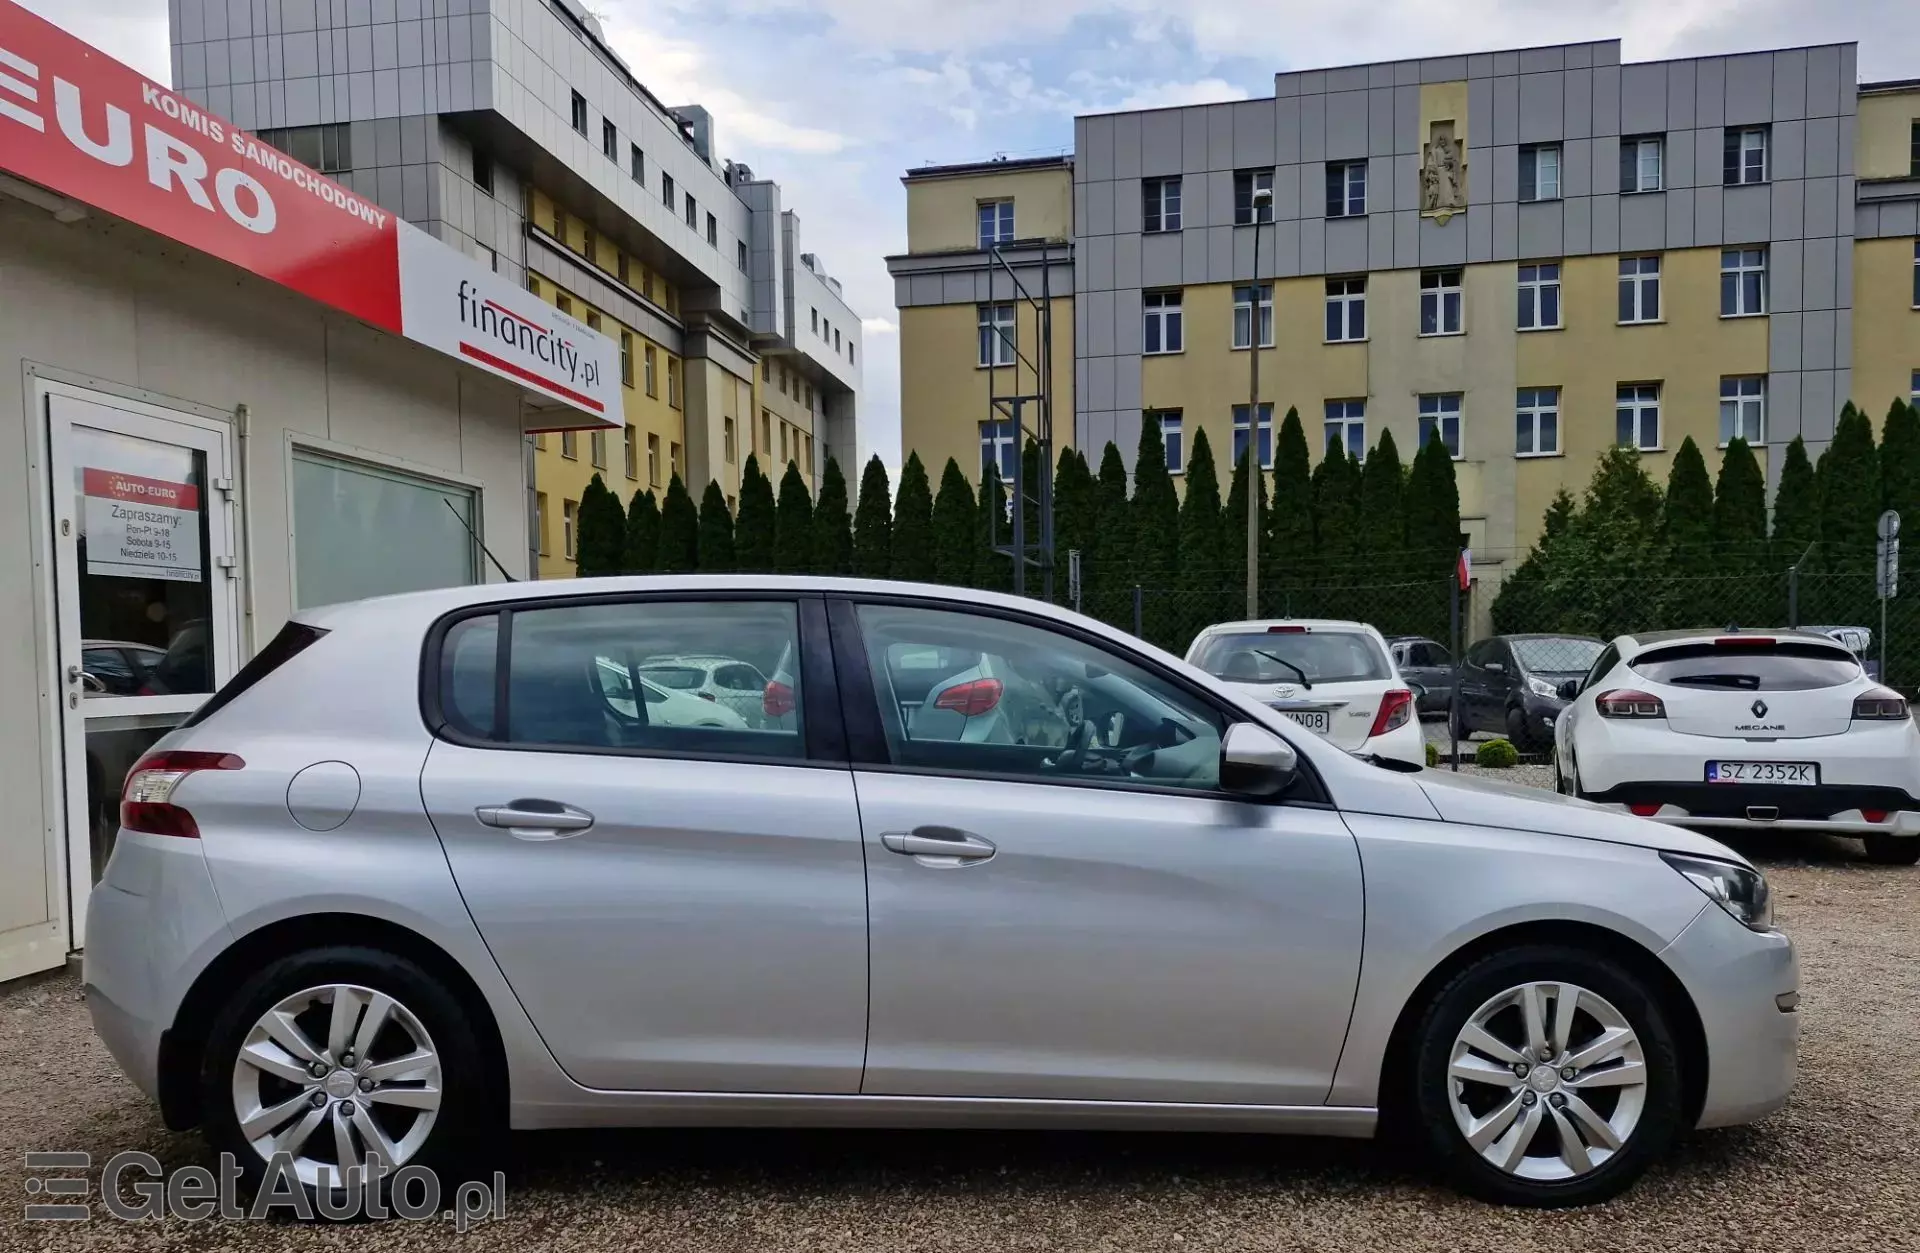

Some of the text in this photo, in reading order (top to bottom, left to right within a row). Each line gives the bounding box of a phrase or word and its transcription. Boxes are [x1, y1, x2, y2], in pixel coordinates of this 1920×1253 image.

[142, 81, 387, 231] KOMIS SAMOCHODOWY
[458, 279, 601, 388] financity.pl
[115, 481, 177, 499] AUTO-EURO
[111, 504, 182, 529] Zapraszamy:
[126, 536, 153, 548] Sobota
[120, 547, 177, 561] Niedziela 10-15
[1720, 763, 1745, 779] SZ
[1752, 764, 1810, 781] 2352K
